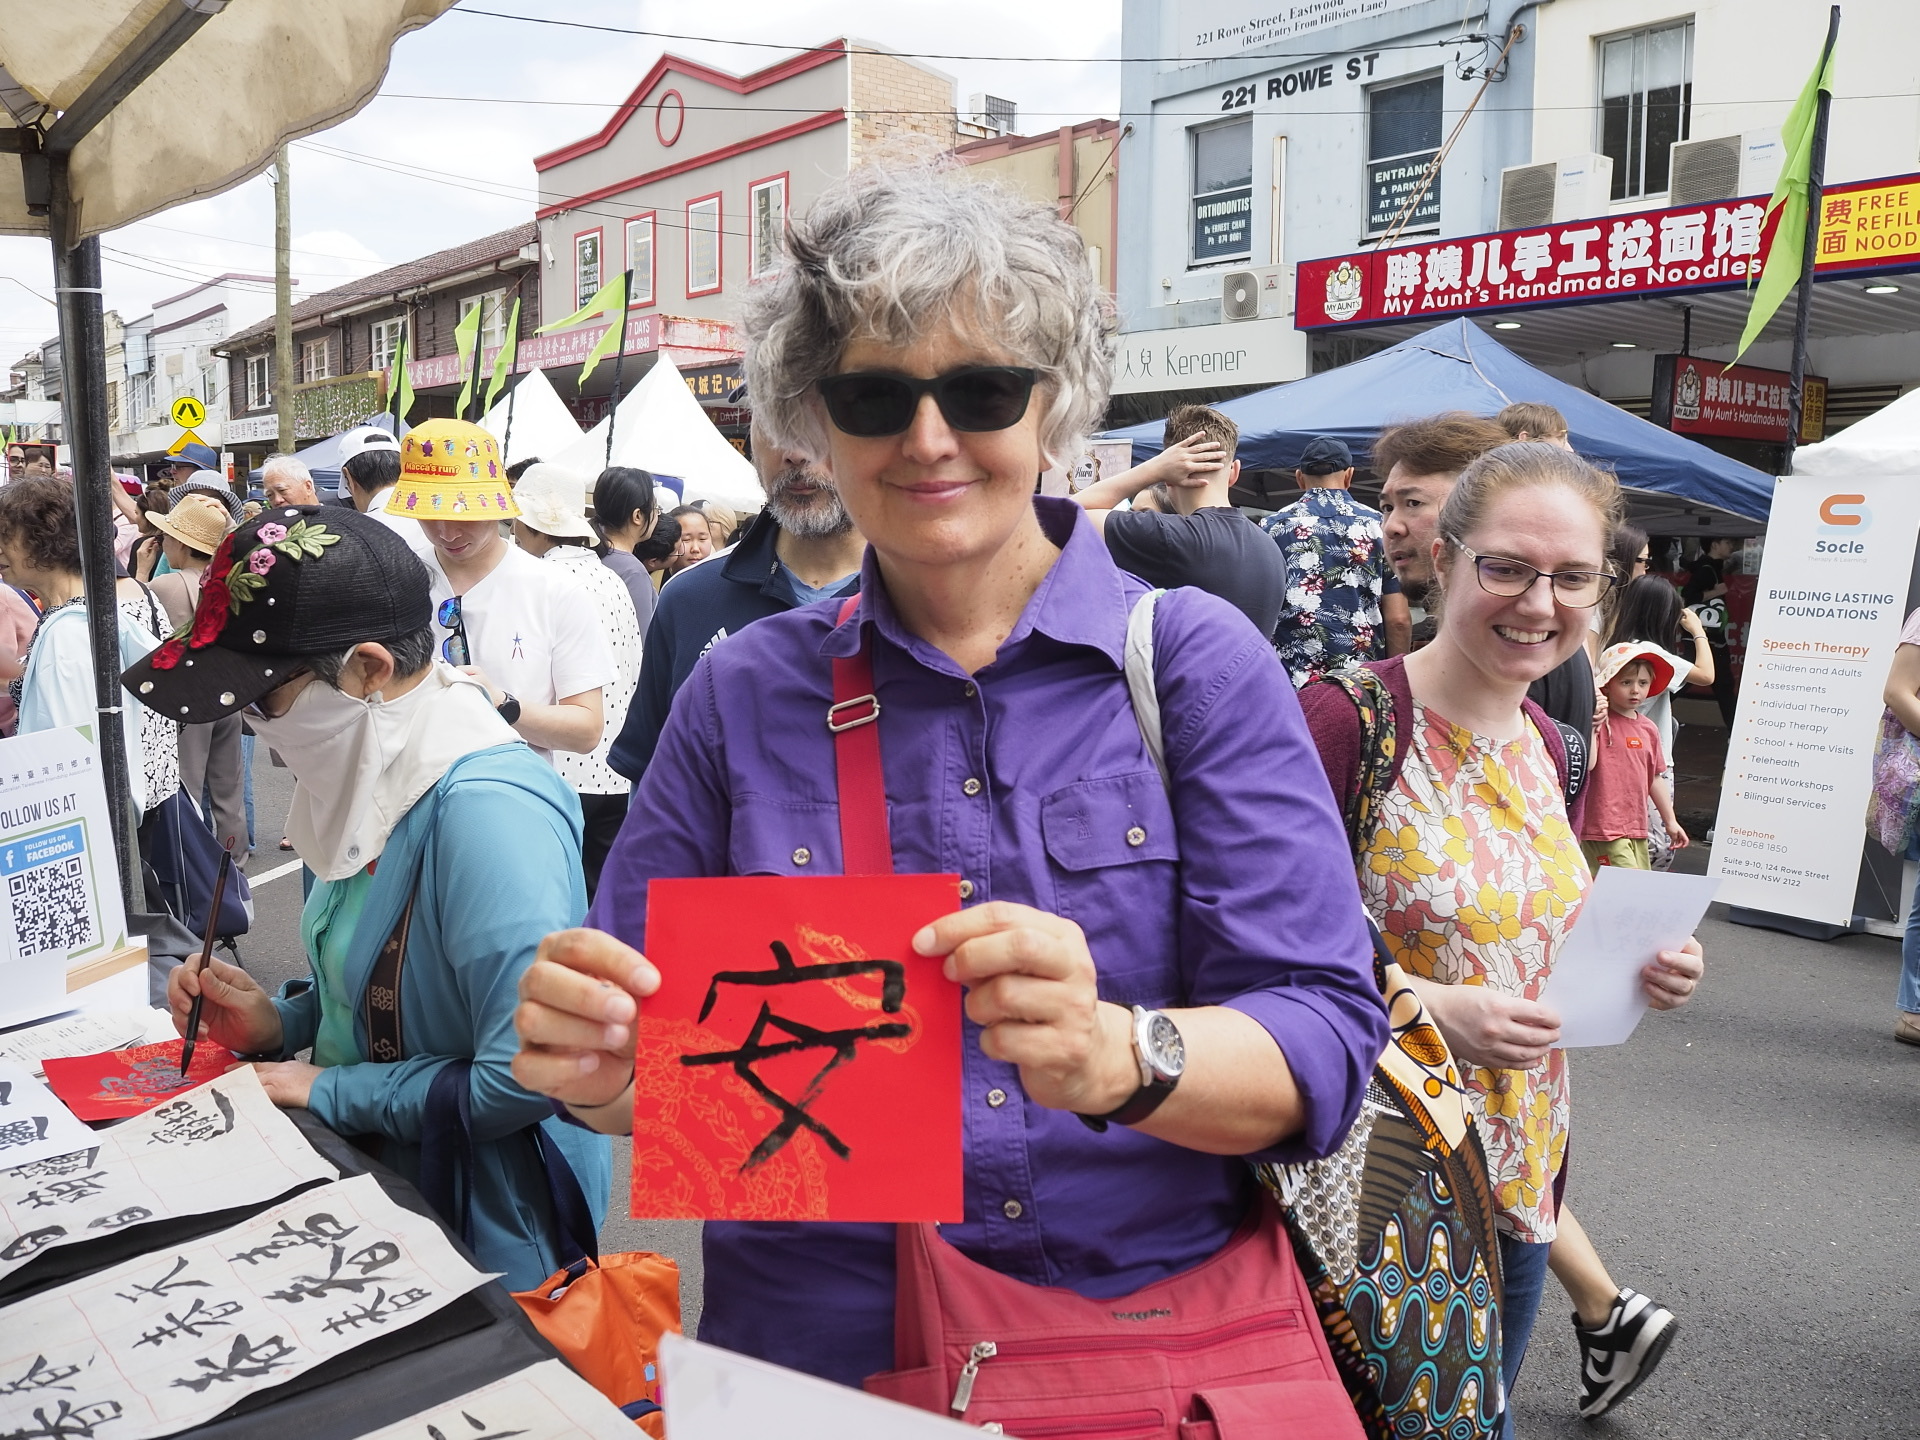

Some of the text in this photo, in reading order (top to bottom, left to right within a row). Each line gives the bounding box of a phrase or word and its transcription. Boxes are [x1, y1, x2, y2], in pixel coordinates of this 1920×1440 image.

[1196, 33, 1213, 47] 221
[1217, 25, 1246, 40] Rowe
[1249, 14, 1286, 31] Street,
[1242, 0, 1388, 47] (Rear Entry From Hillview Lane)
[1221, 53, 1380, 111] 221 ROWE ST
[1380, 186, 1387, 195] &
[1379, 199, 1390, 209] AT
[1424, 192, 1433, 201] IN
[1858, 191, 1909, 212] FREE
[1416, 204, 1440, 216] LANE
[1823, 229, 1848, 254] 面
[1856, 231, 1918, 252] NOOD
[1383, 258, 1762, 315] My Aunt's Handmade Noodles
[1326, 303, 1337, 313] MY
[1166, 345, 1247, 376] Kerener
[1703, 406, 1714, 422] My
[1739, 410, 1775, 426] Handmade
[1776, 414, 1789, 427] Noo
[405, 462, 461, 475] Macca's run?
[1815, 541, 1864, 553] Socle
[1769, 589, 1894, 604] BUILDING LASTING
[1778, 605, 1878, 620] FOUNDATIONS
[1763, 639, 1870, 658] Speech Therapy
[1766, 663, 1862, 677] Children and Adults
[1763, 681, 1827, 694] Assessments
[1760, 700, 1850, 717] Individual Therapy
[1757, 718, 1828, 734] Group Therapy
[1753, 737, 1786, 747] School
[1796, 742, 1826, 752] Home
[1828, 744, 1854, 755] Visits
[1565, 734, 1582, 795] GUESS
[1751, 755, 1800, 768] Telehealth
[1747, 773, 1834, 792] Parent Workshops
[1743, 792, 1827, 810] Bilingual Services
[0, 793, 76, 829] OLLOW US AT
[1730, 826, 1775, 840] Telephone
[24, 840, 48, 851] FOLLOW
[57, 834, 66, 842] ON
[26, 840, 75, 862] FACEBOOK
[1726, 837, 1788, 854] 02 8068 1850
[1721, 867, 1801, 887] Eastwood NSW 2122
[1723, 856, 1830, 880] Suite 9-10, 124 Rowe Street
[680, 940, 912, 1178] 安
